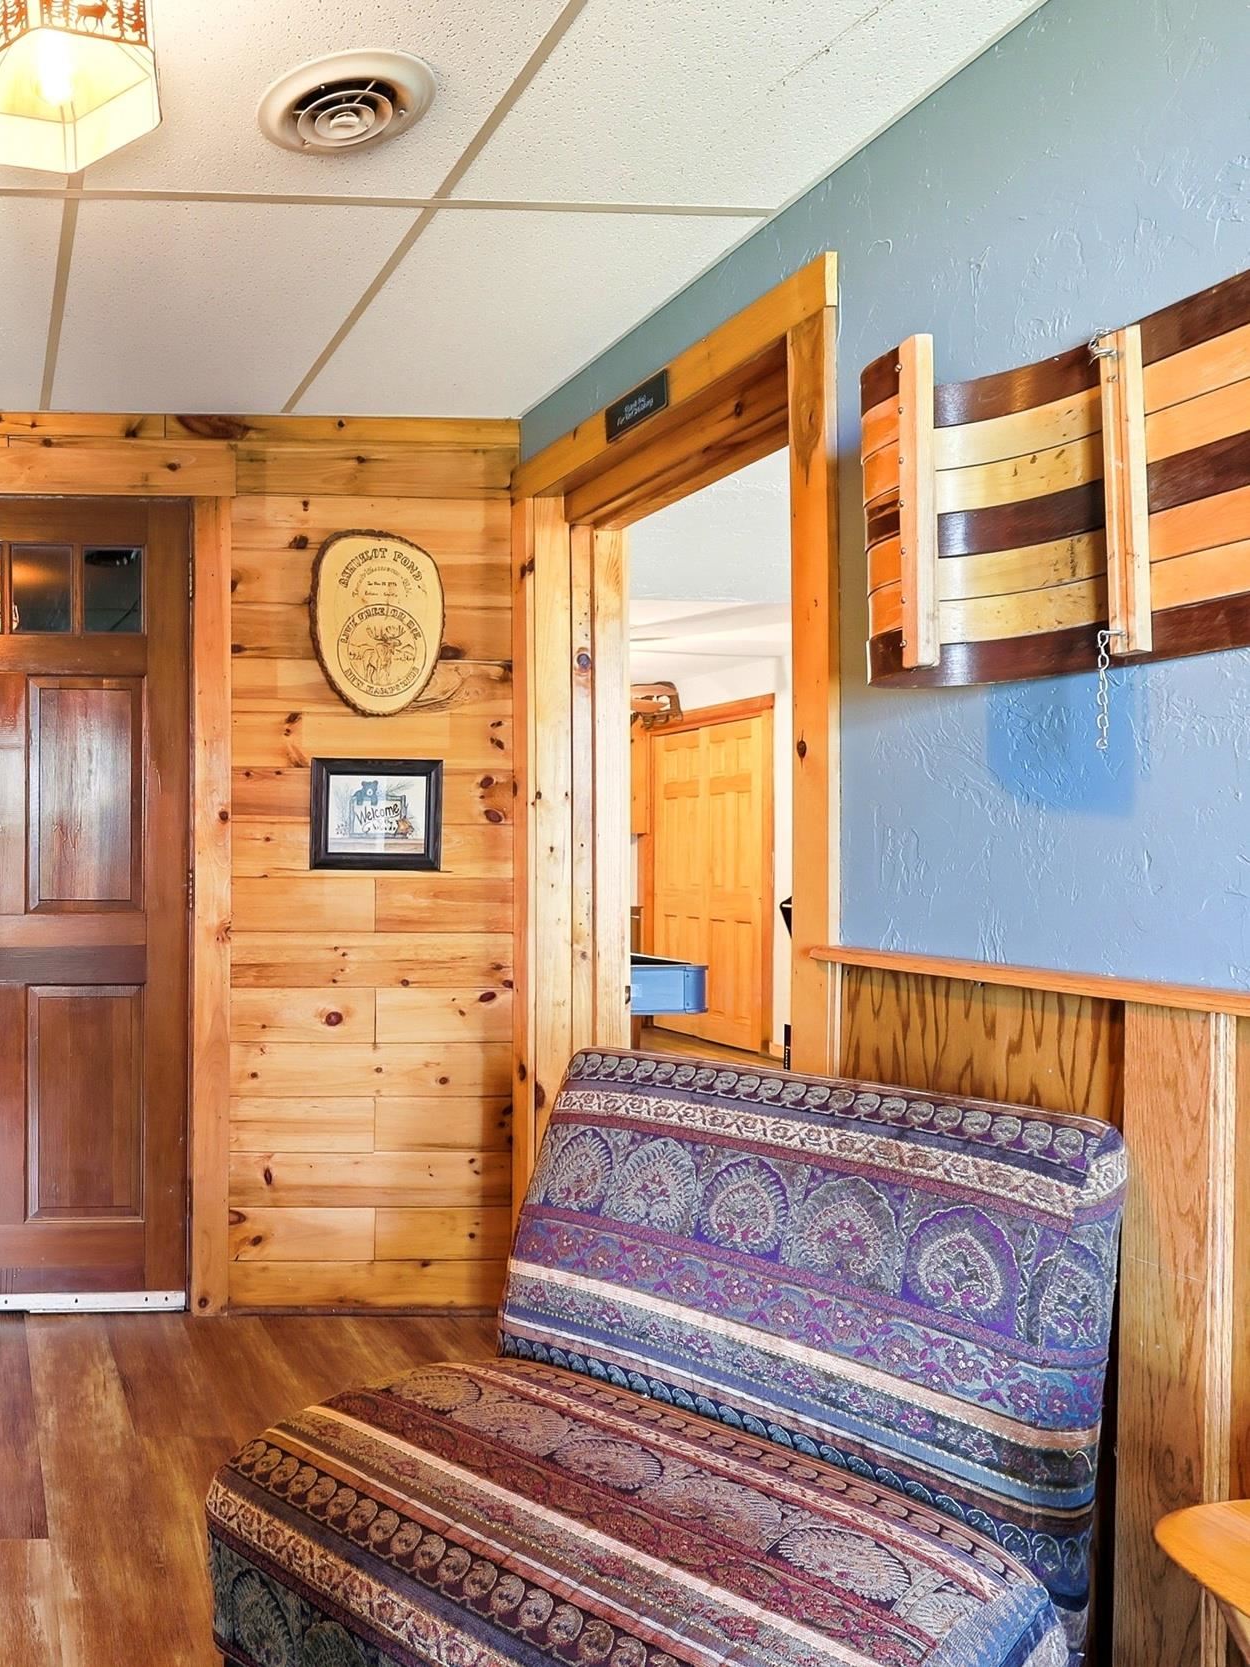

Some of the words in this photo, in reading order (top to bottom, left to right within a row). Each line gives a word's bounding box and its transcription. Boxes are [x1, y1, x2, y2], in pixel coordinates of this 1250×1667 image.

[393, 550, 423, 581] POND
[357, 607, 385, 621] FREE
[390, 608, 407, 622] OR
[406, 619, 422, 641] DIE
[355, 803, 400, 825] Welcome
